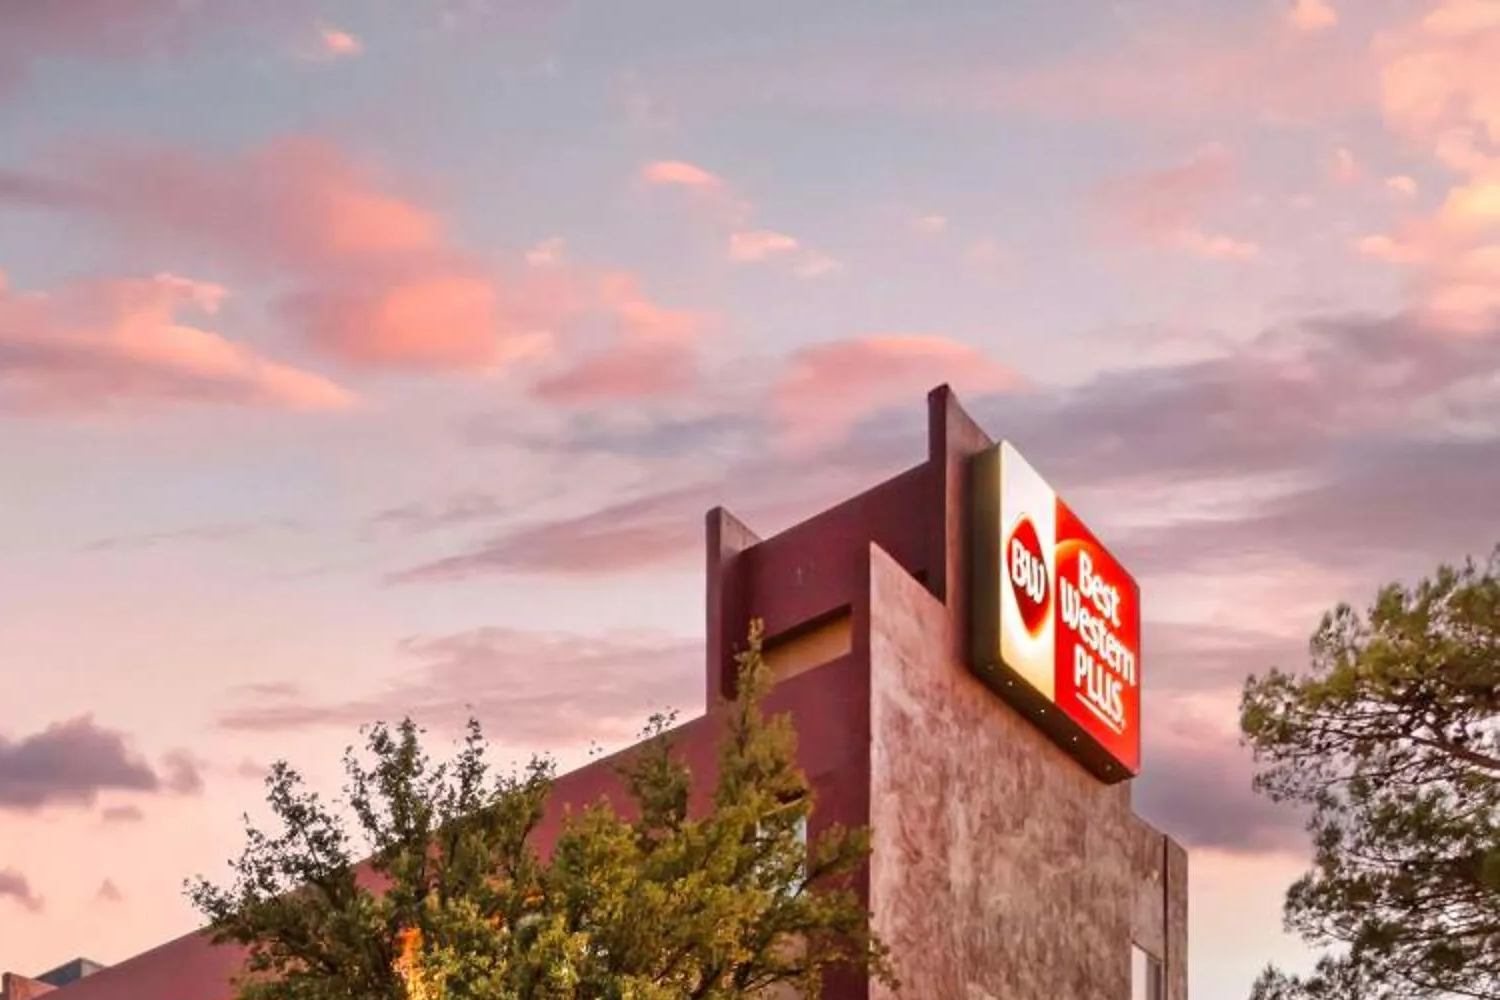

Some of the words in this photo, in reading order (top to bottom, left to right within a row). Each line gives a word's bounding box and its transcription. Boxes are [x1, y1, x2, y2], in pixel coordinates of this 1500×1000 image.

[1011, 538, 1045, 604] BW
[1079, 549, 1121, 627] Best
[1059, 577, 1136, 686] Western
